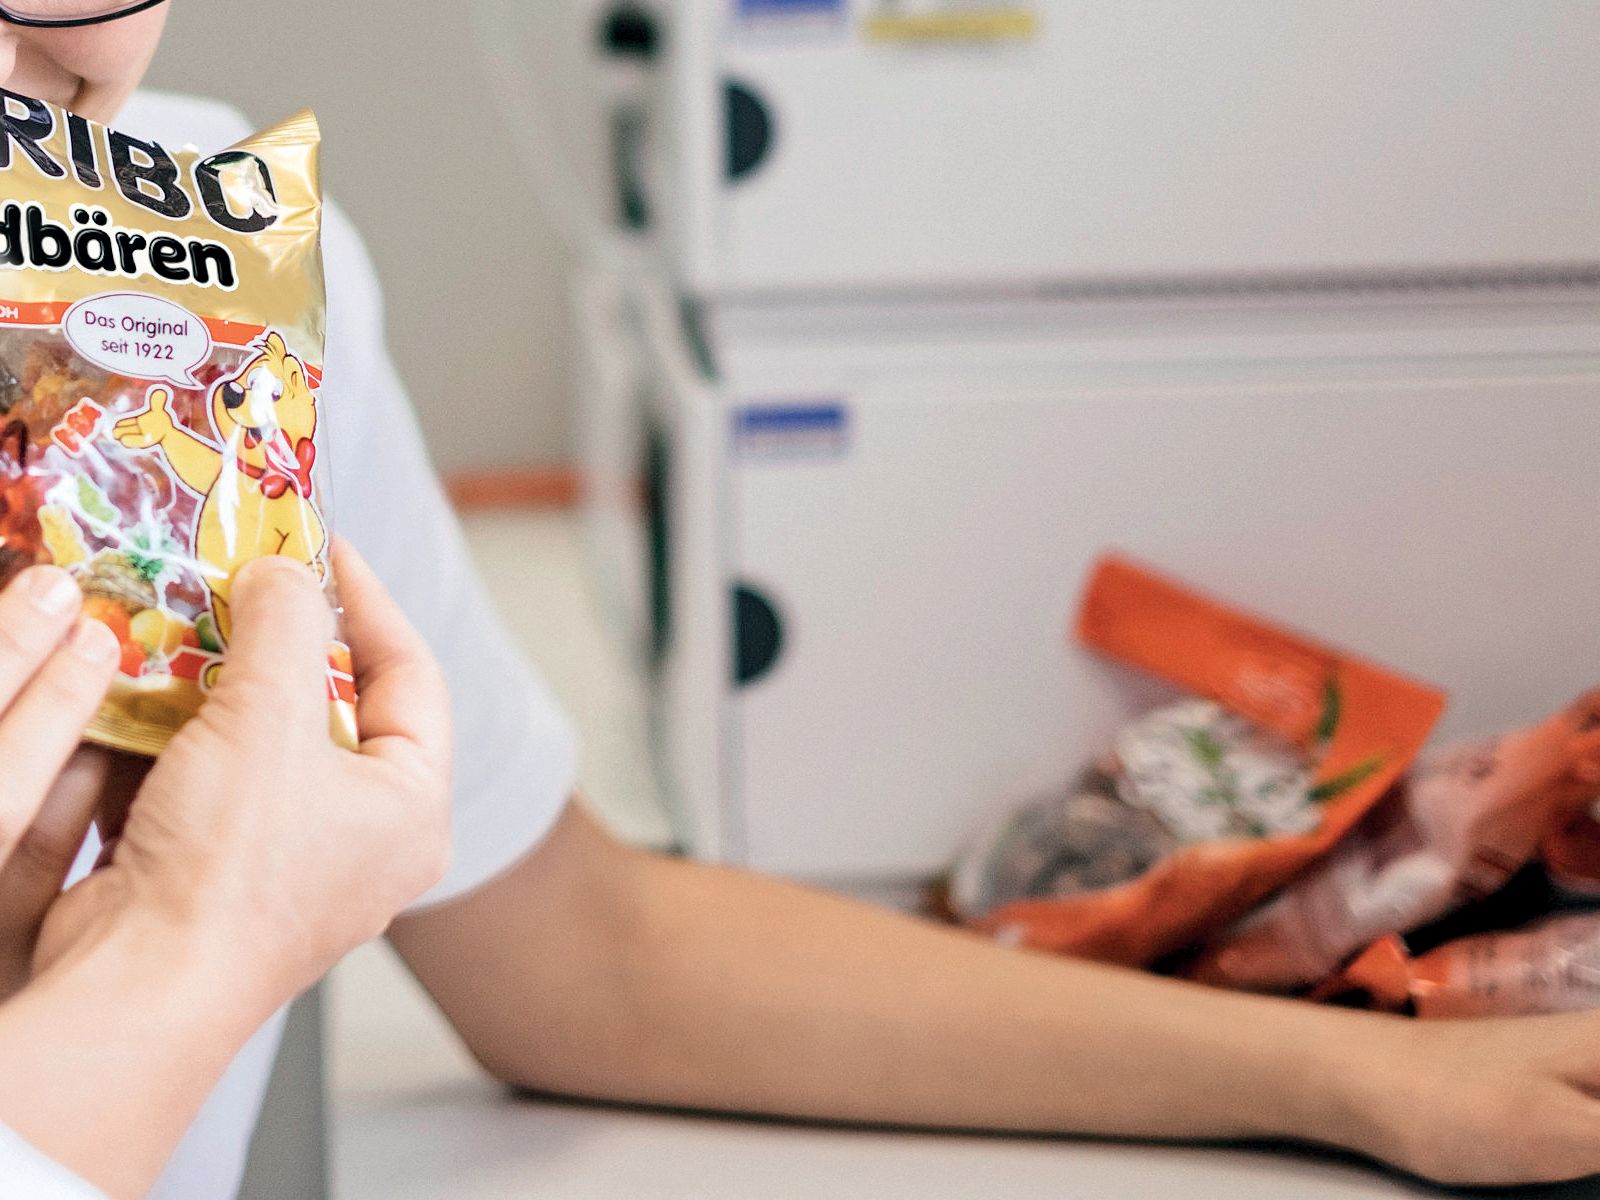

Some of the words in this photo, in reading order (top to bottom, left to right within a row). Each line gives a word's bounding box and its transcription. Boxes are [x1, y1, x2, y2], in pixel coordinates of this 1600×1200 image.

[84, 310, 116, 329] Das
[121, 315, 188, 339] Original
[101, 339, 129, 354] seit
[135, 341, 174, 360] 1922
